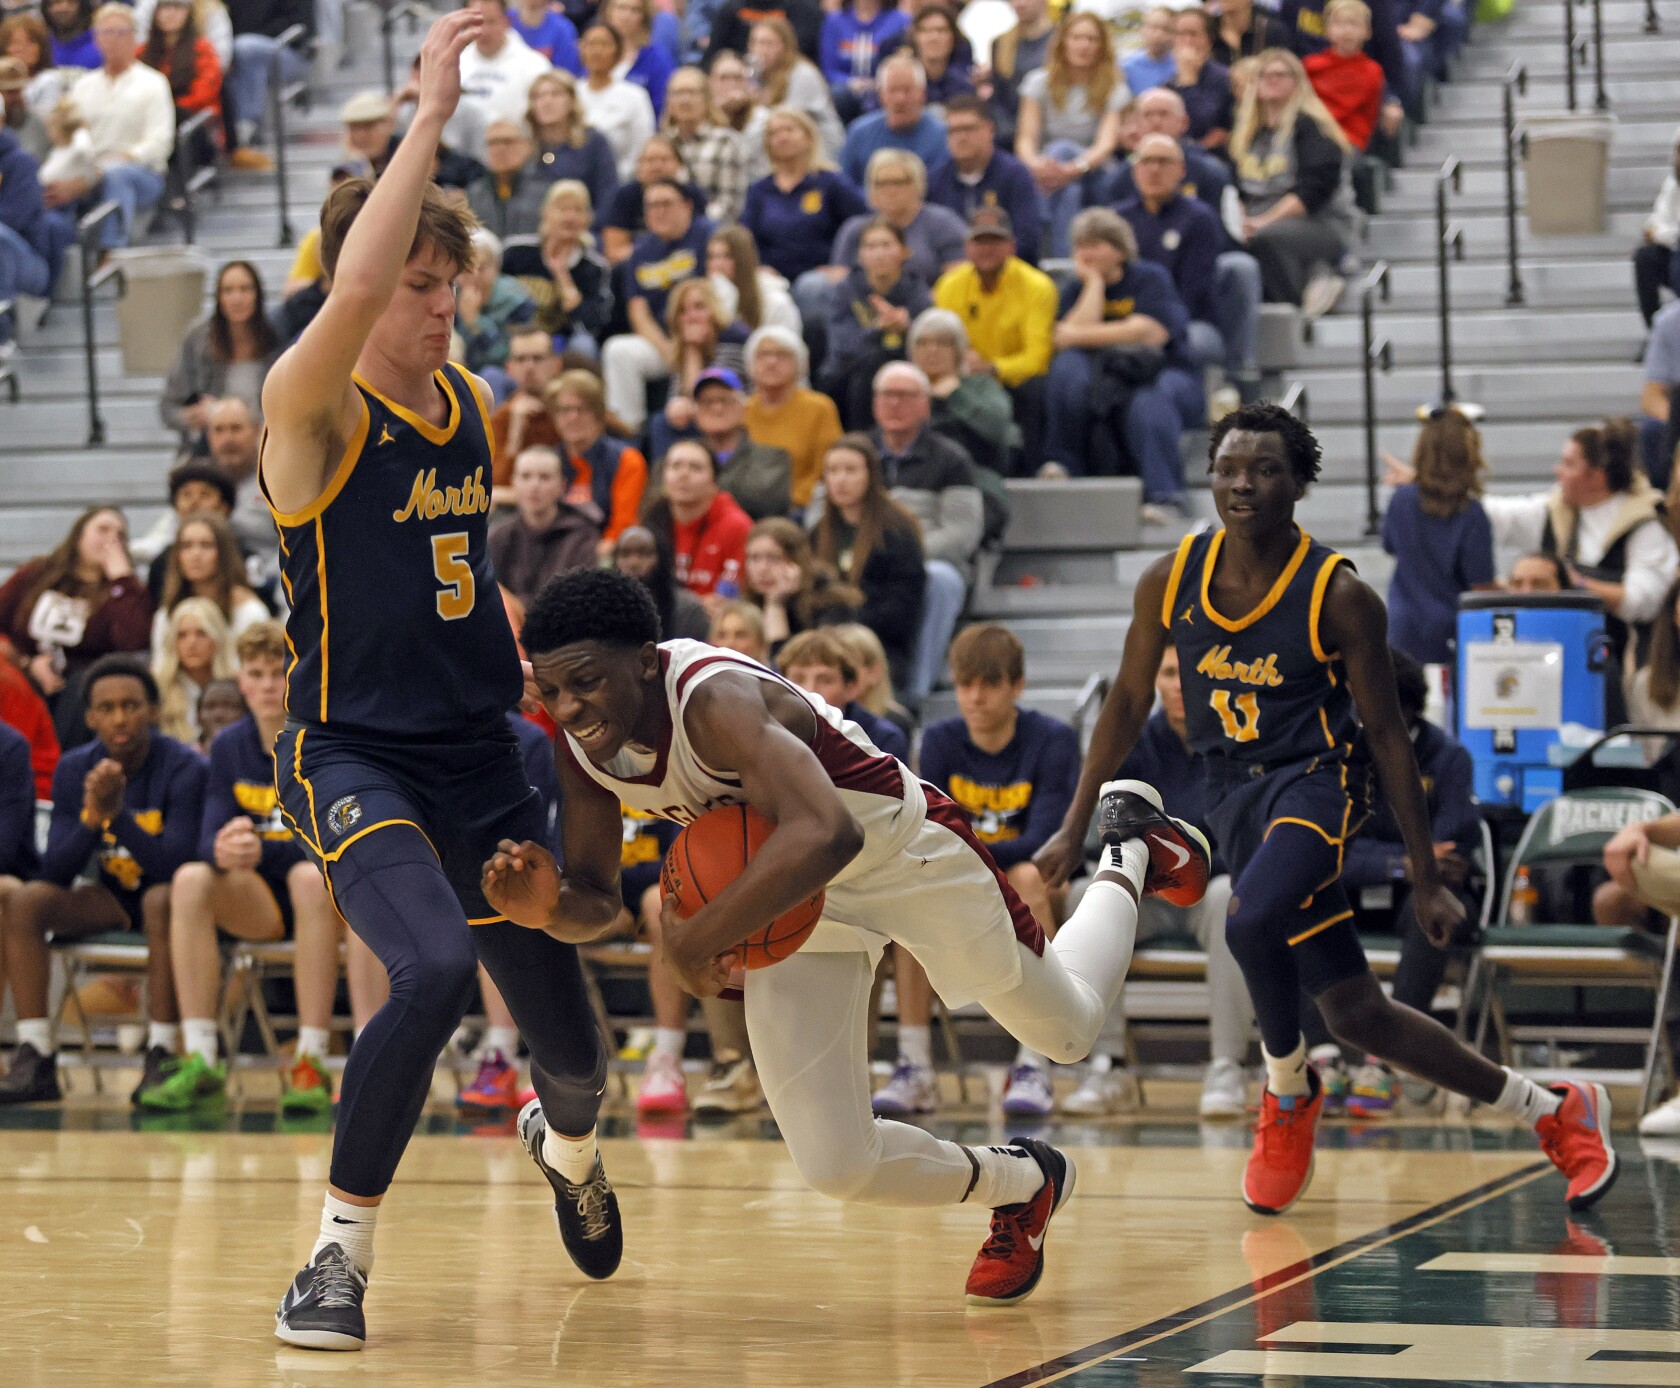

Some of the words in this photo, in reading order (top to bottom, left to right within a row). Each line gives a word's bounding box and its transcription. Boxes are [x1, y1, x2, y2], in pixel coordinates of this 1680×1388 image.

[393, 465, 489, 523] North
[430, 531, 476, 622] 5
[1196, 644, 1284, 687] North
[1209, 688, 1260, 743] 11
